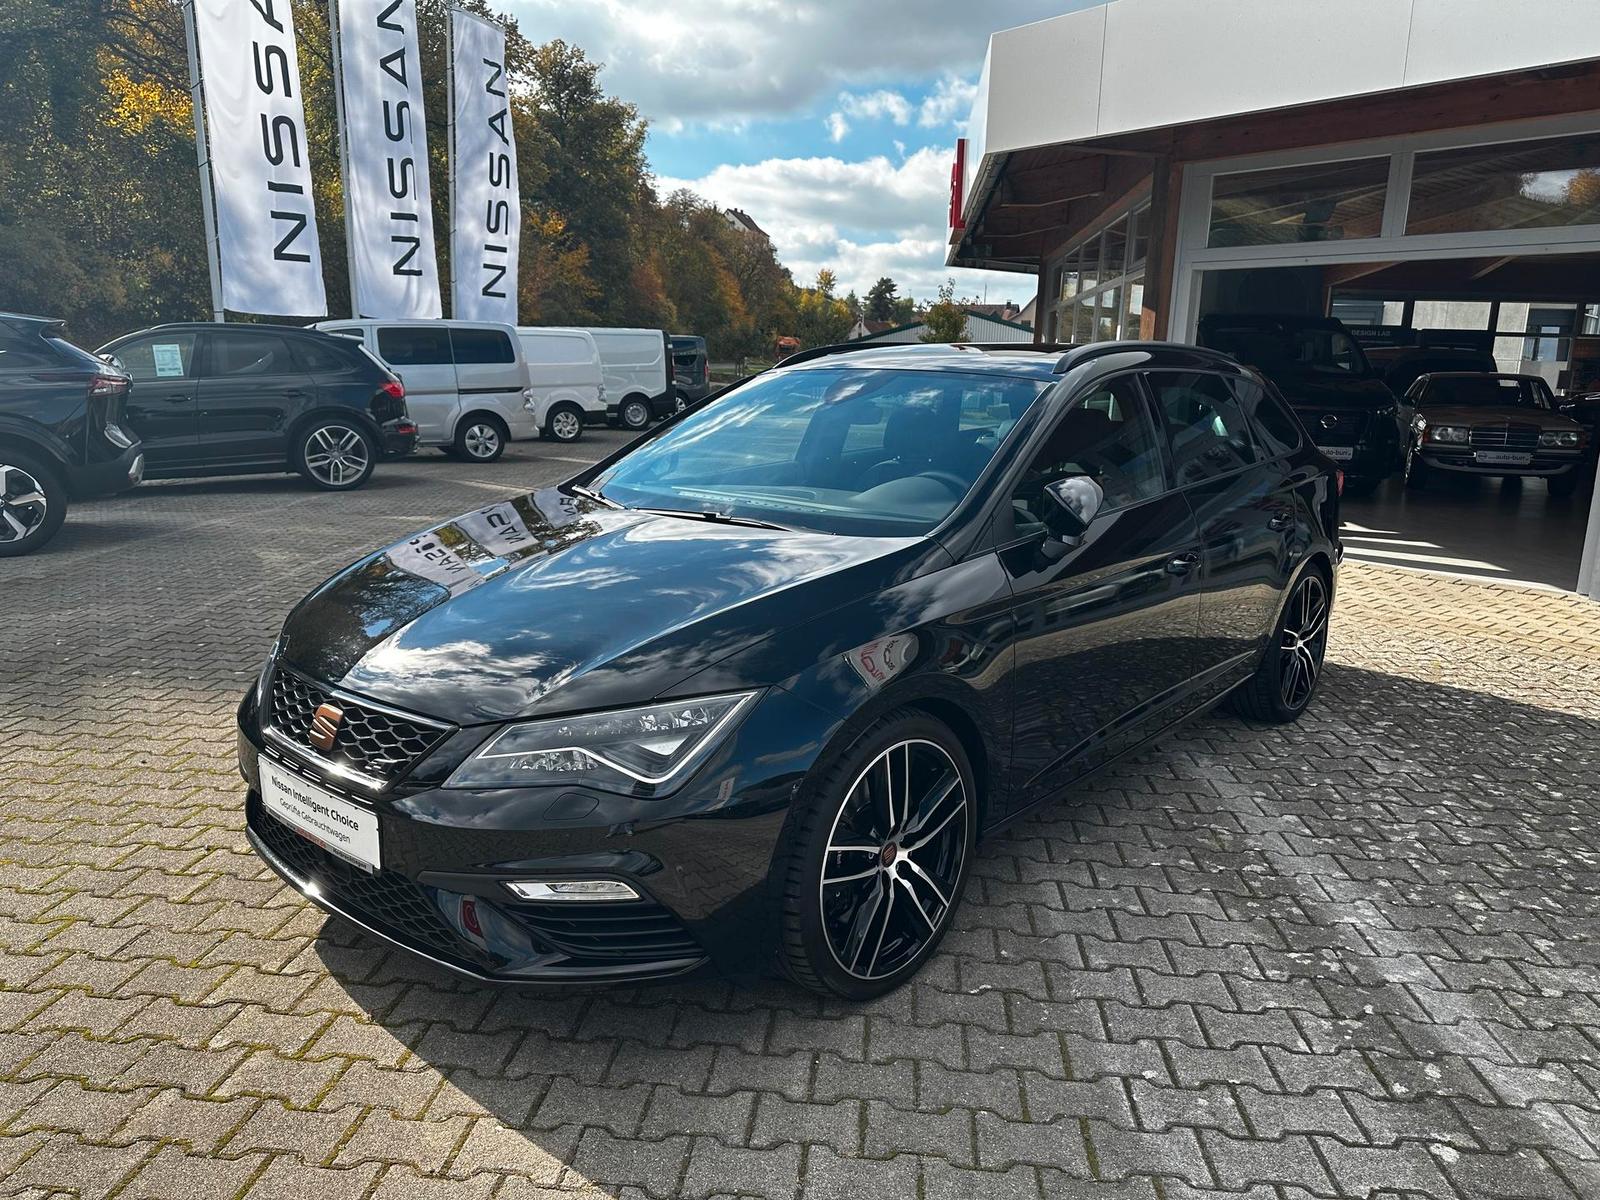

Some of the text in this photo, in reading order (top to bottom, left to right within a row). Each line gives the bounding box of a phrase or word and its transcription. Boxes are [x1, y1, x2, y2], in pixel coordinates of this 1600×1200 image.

[376, 0, 423, 276] NISSAN
[481, 57, 510, 299] NISSAN
[271, 775, 292, 797] Nissan
[292, 787, 330, 817] Intelligent
[330, 809, 359, 831] Choice
[301, 811, 351, 844] Gebrauchtwagen
